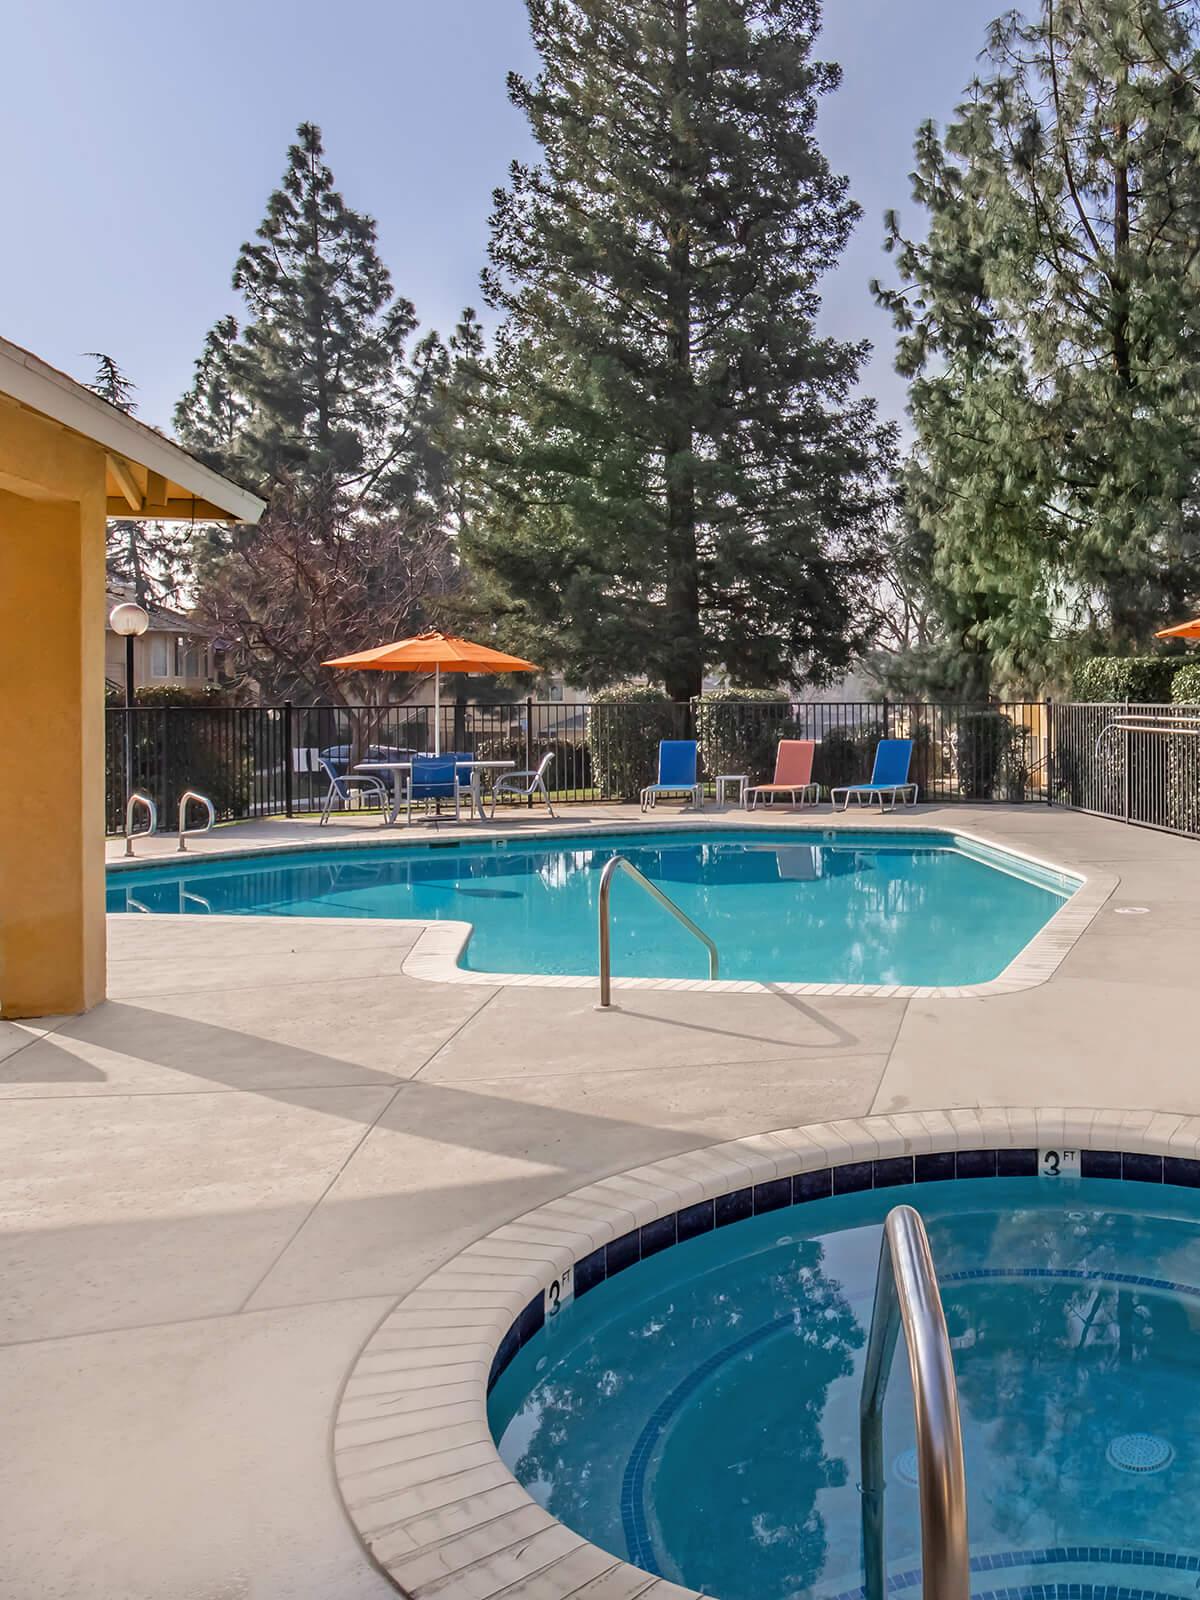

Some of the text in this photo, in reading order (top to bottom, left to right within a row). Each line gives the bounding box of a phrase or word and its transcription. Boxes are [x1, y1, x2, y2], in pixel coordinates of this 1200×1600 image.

[1044, 1150, 1075, 1176] 3 FT
[549, 1268, 571, 1316] 3 FT
